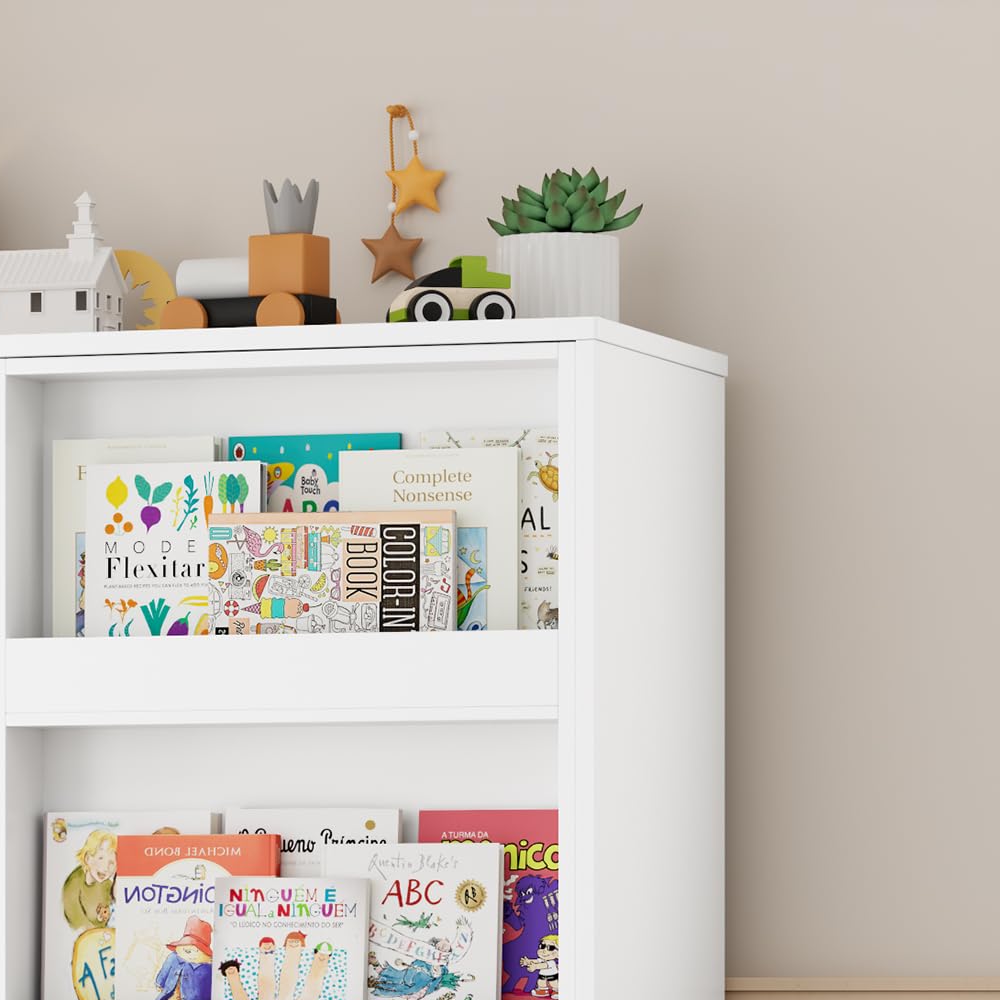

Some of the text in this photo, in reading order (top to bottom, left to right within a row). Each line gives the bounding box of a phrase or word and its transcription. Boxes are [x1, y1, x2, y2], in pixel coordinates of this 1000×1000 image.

[301, 476, 319, 487] Baby
[392, 469, 472, 487] Complete
[300, 486, 321, 495] Touch
[392, 489, 472, 503] Nonsense
[104, 556, 206, 580] Flexitar
[346, 541, 378, 600] BOOK
[441, 831, 489, 839] A TURMA DA
[381, 878, 445, 908] ABC
[219, 903, 267, 918] IGUAL
